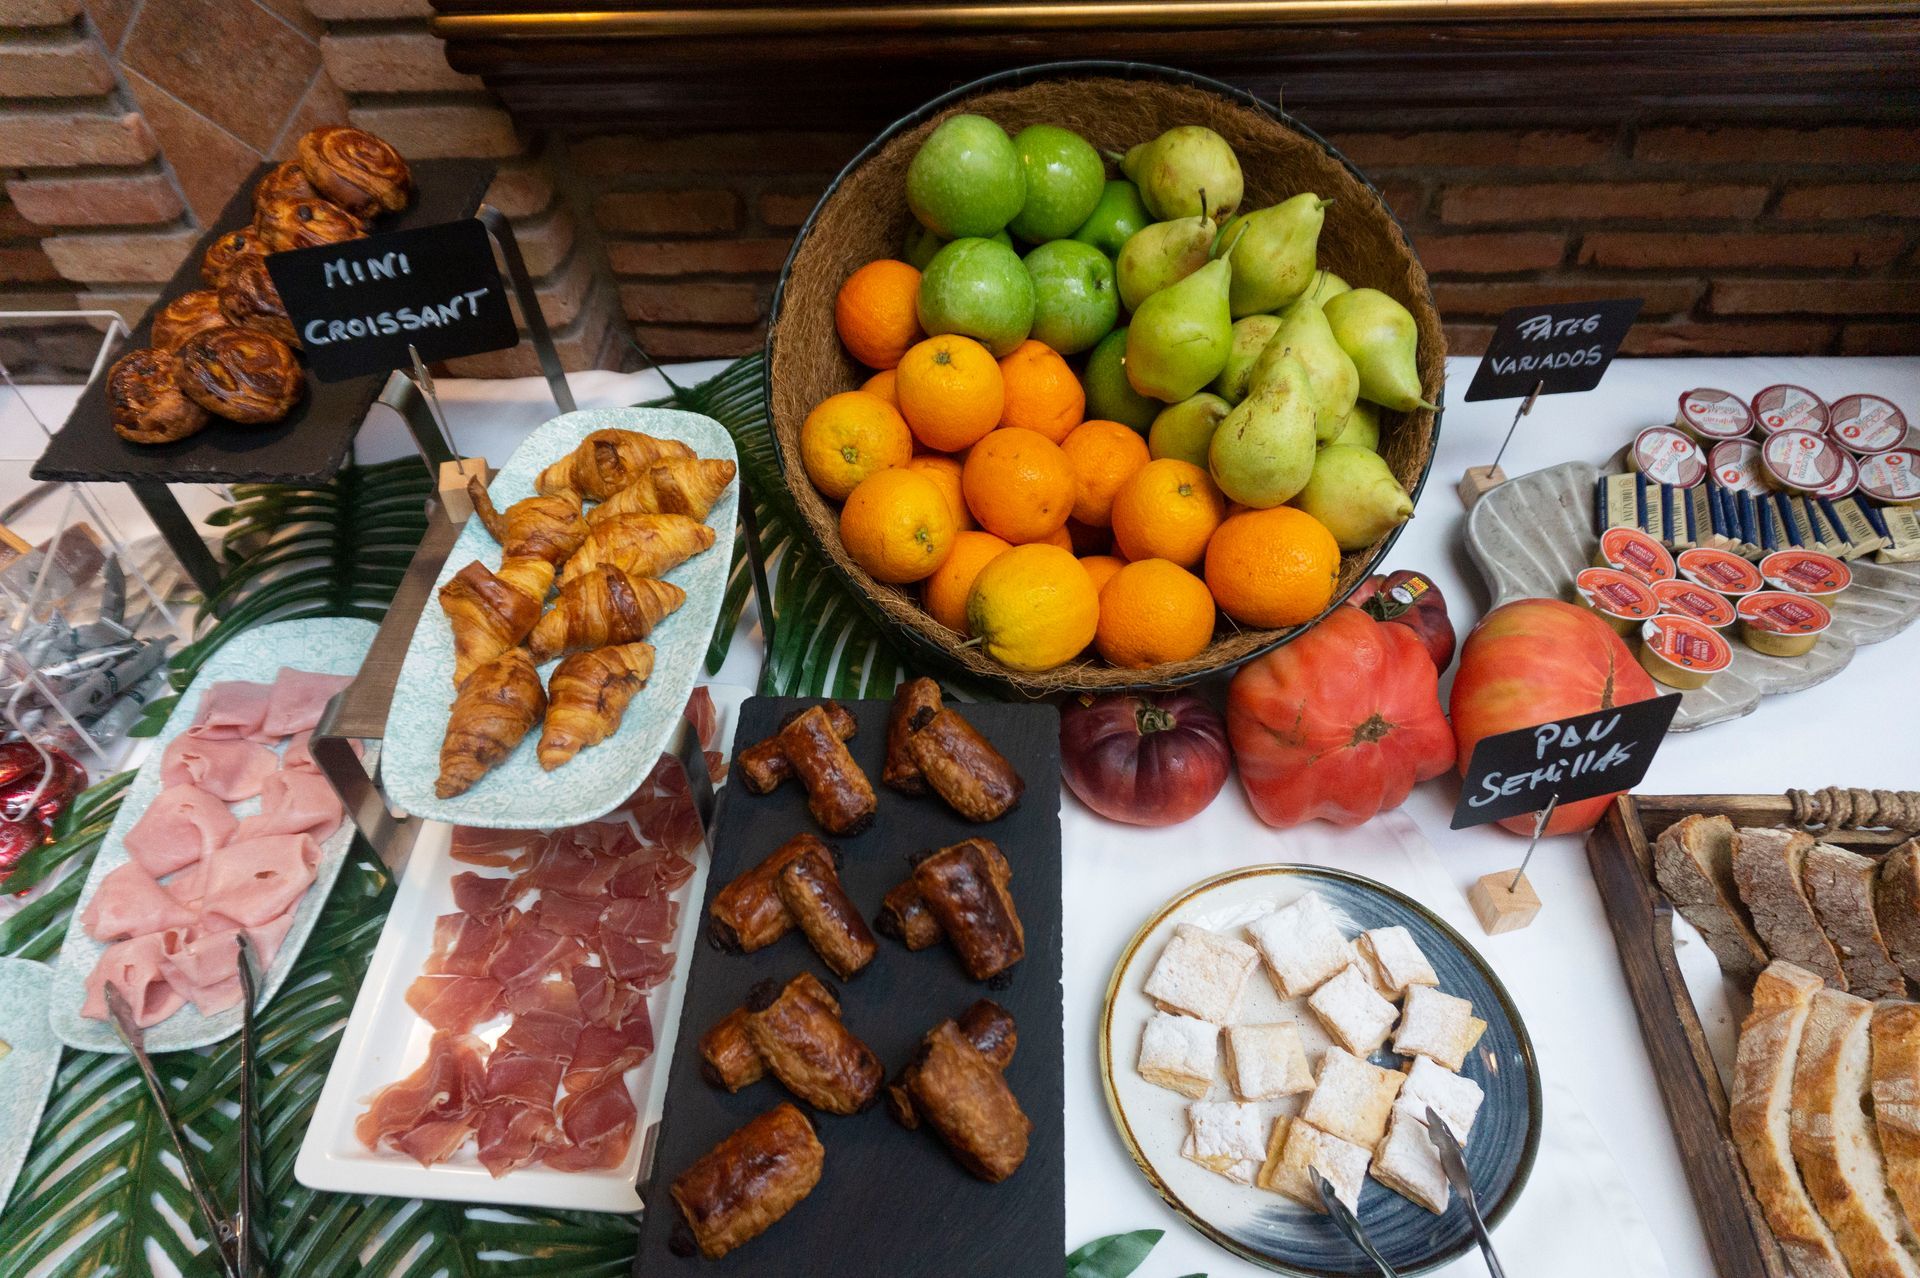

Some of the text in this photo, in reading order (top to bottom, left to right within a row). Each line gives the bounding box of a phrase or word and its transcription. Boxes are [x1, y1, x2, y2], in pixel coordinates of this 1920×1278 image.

[323, 252, 412, 289] MINI
[304, 287, 489, 345] CROISSANT
[1516, 314, 1602, 341] PATES
[1491, 344, 1602, 376] VARIADOS
[1534, 713, 1622, 760] PAN
